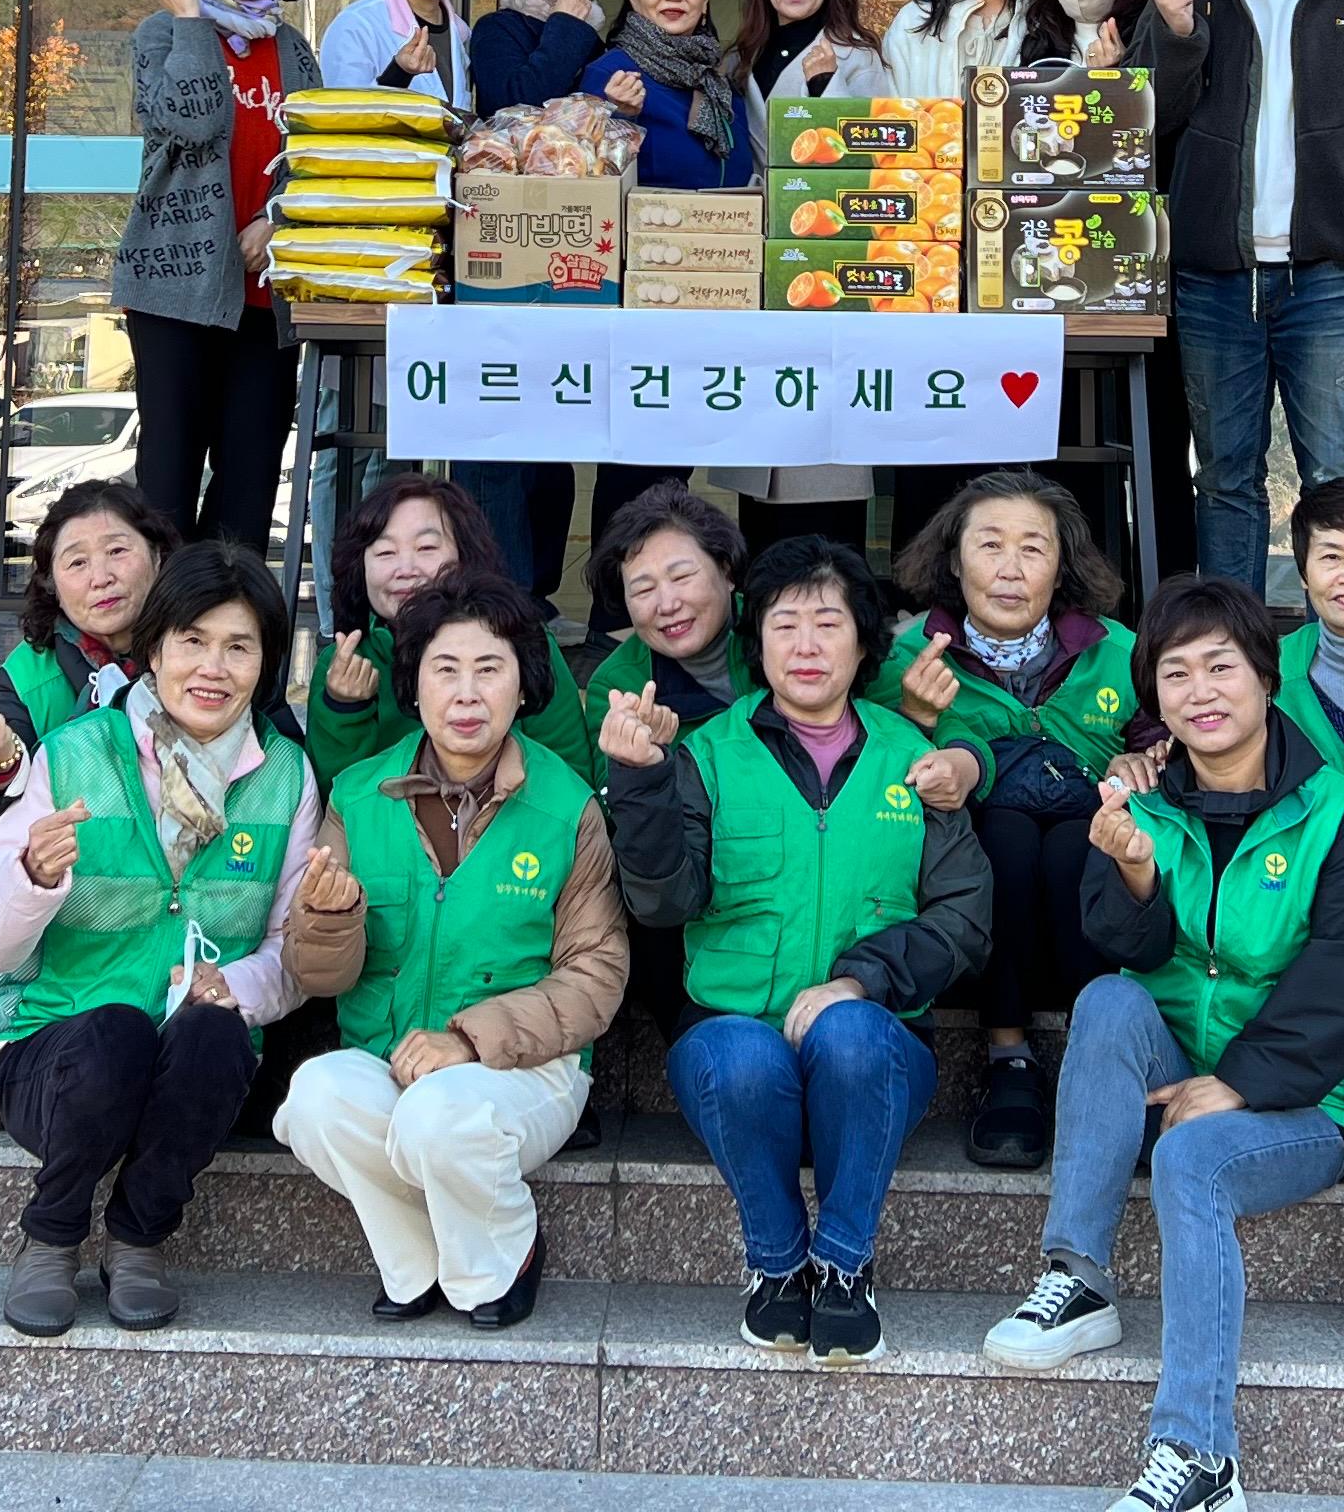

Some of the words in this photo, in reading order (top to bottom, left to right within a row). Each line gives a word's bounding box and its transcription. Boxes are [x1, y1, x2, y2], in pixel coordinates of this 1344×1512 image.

[1019, 94, 1050, 113] 검은
[1087, 106, 1115, 124] 칼슘
[936, 154, 958, 165] 5kg
[462, 183, 500, 200] paldo
[498, 212, 593, 248] 비빔면
[935, 226, 957, 236] 5kg
[1019, 219, 1051, 238] 검은
[1088, 230, 1116, 249] 칼슘
[933, 298, 955, 309] 5kg
[406, 359, 593, 405] 어르신
[629, 363, 967, 413] 건강하세요
[226, 859, 256, 873] SMU
